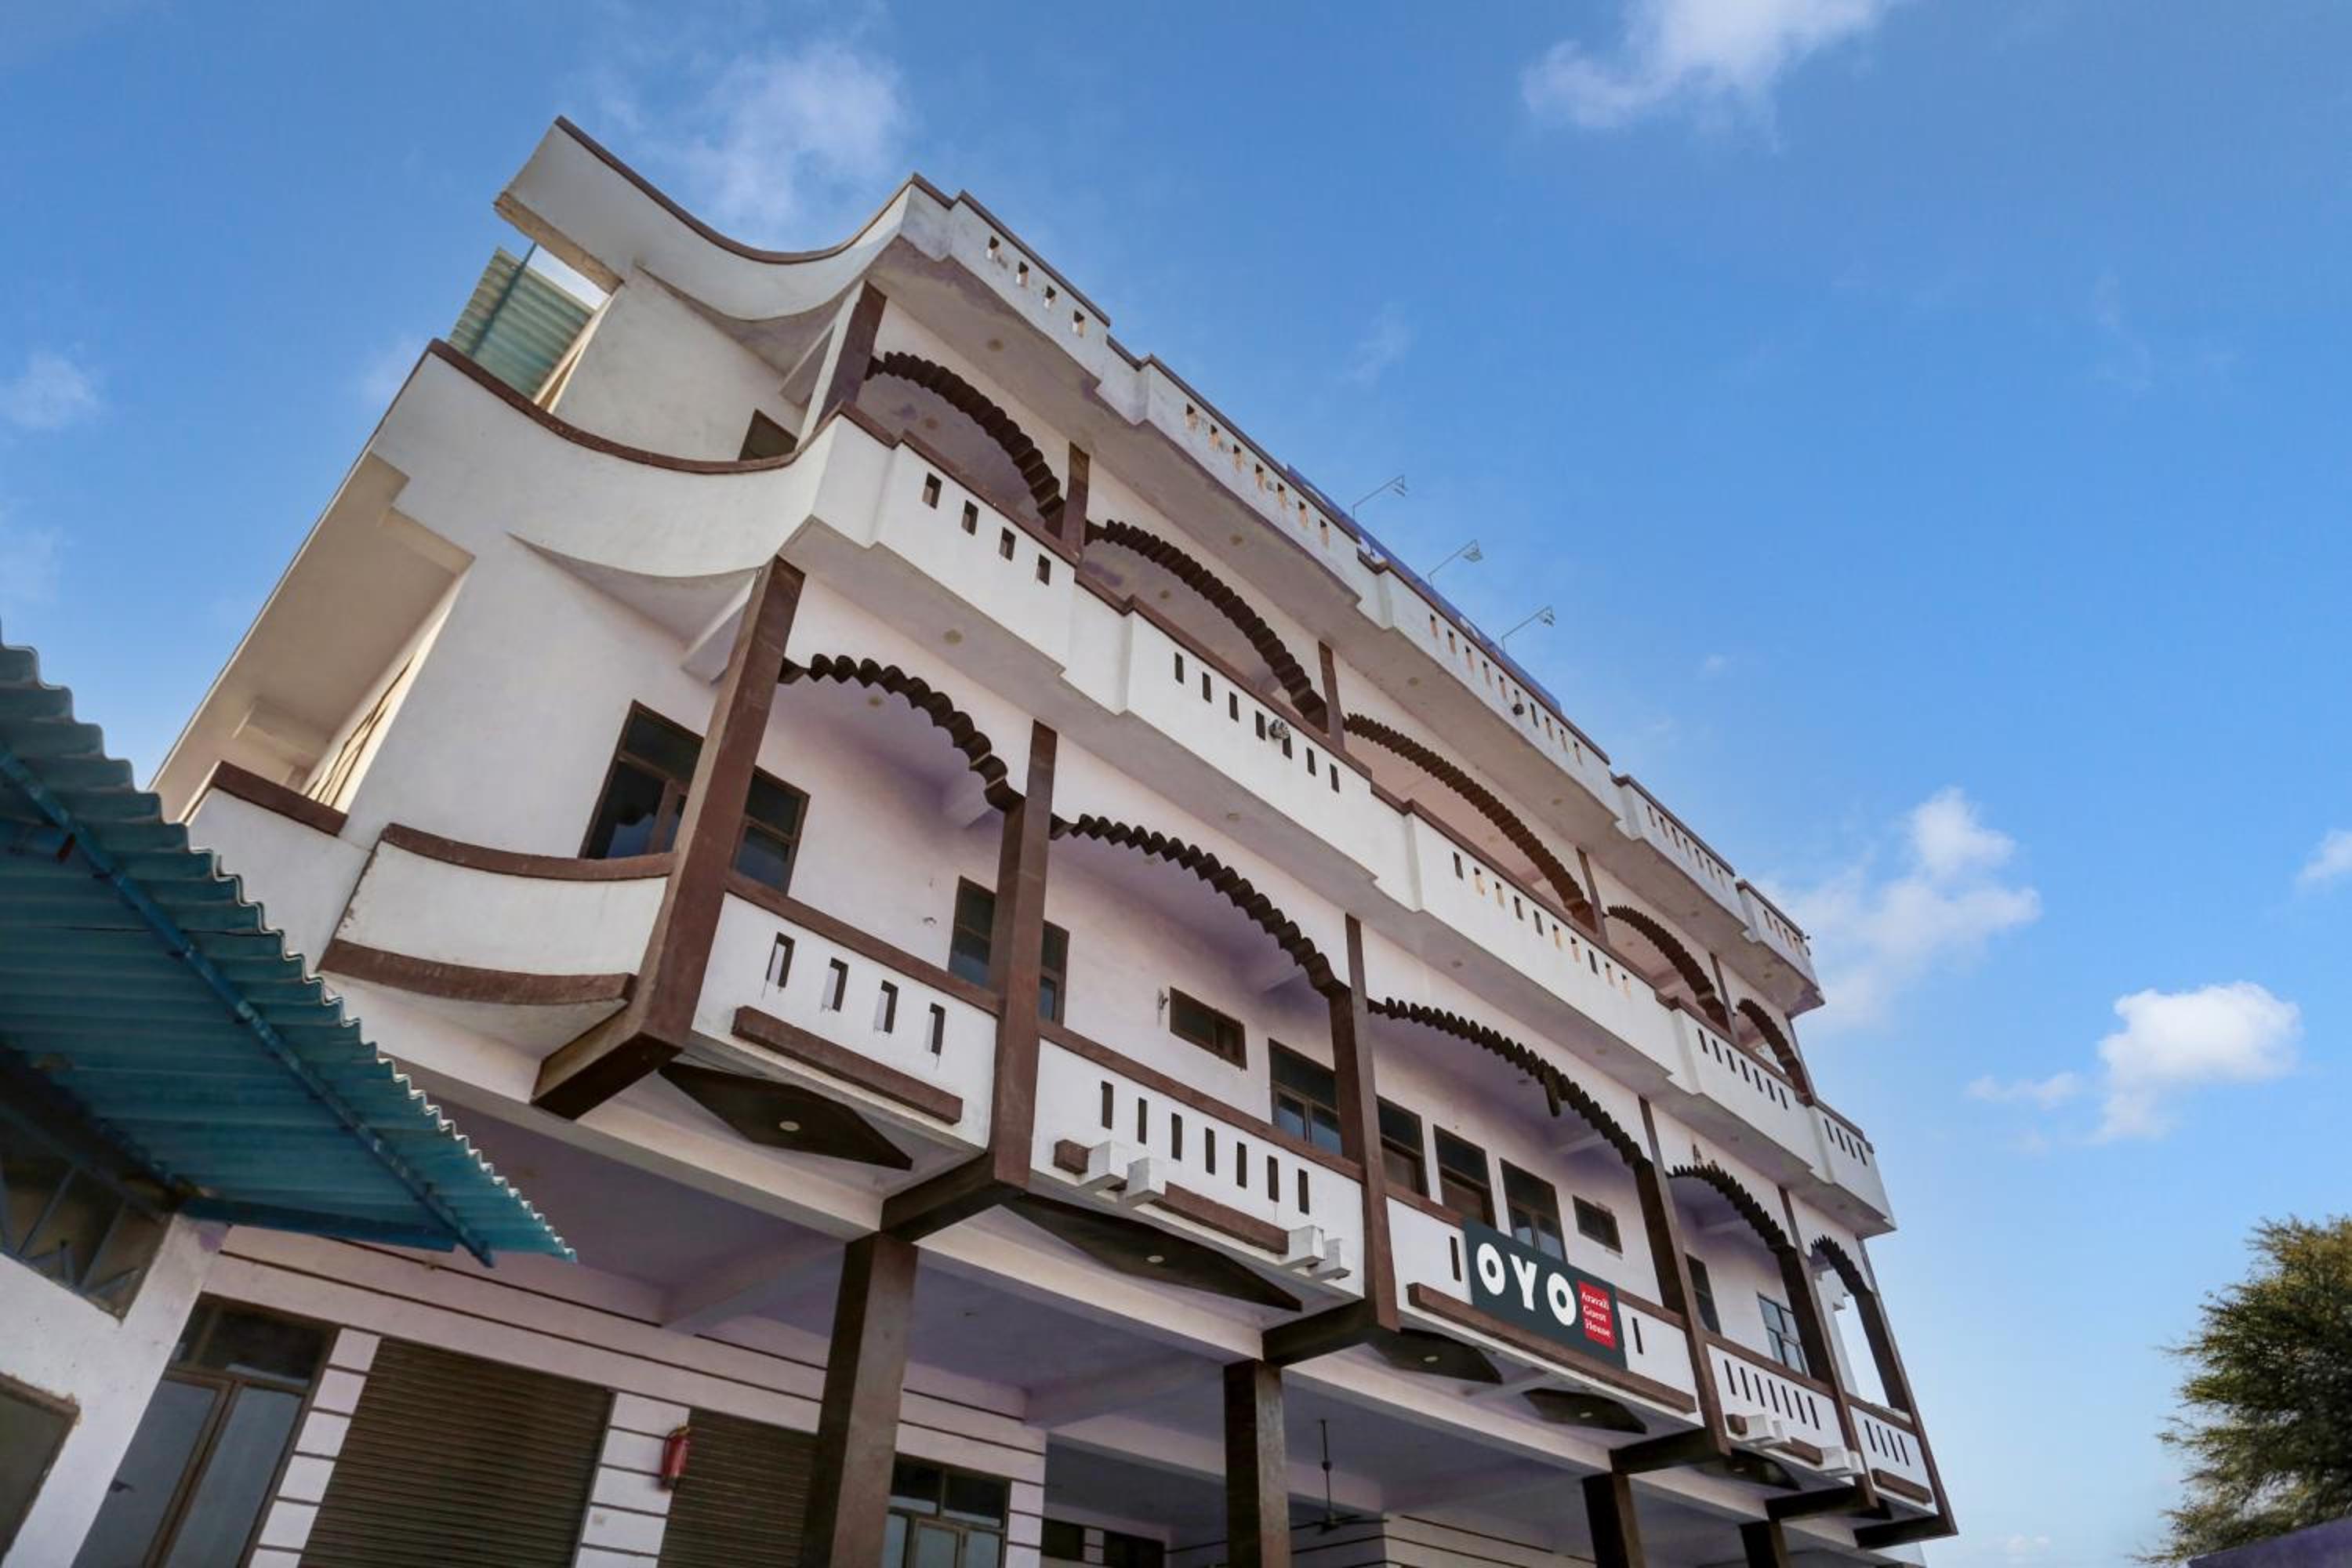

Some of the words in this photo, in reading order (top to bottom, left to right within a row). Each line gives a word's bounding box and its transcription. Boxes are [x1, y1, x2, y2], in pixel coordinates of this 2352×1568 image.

[1477, 1243, 1577, 1326] OYO
[1583, 1305, 1606, 1323] Guest
[1584, 1318, 1611, 1337] House
